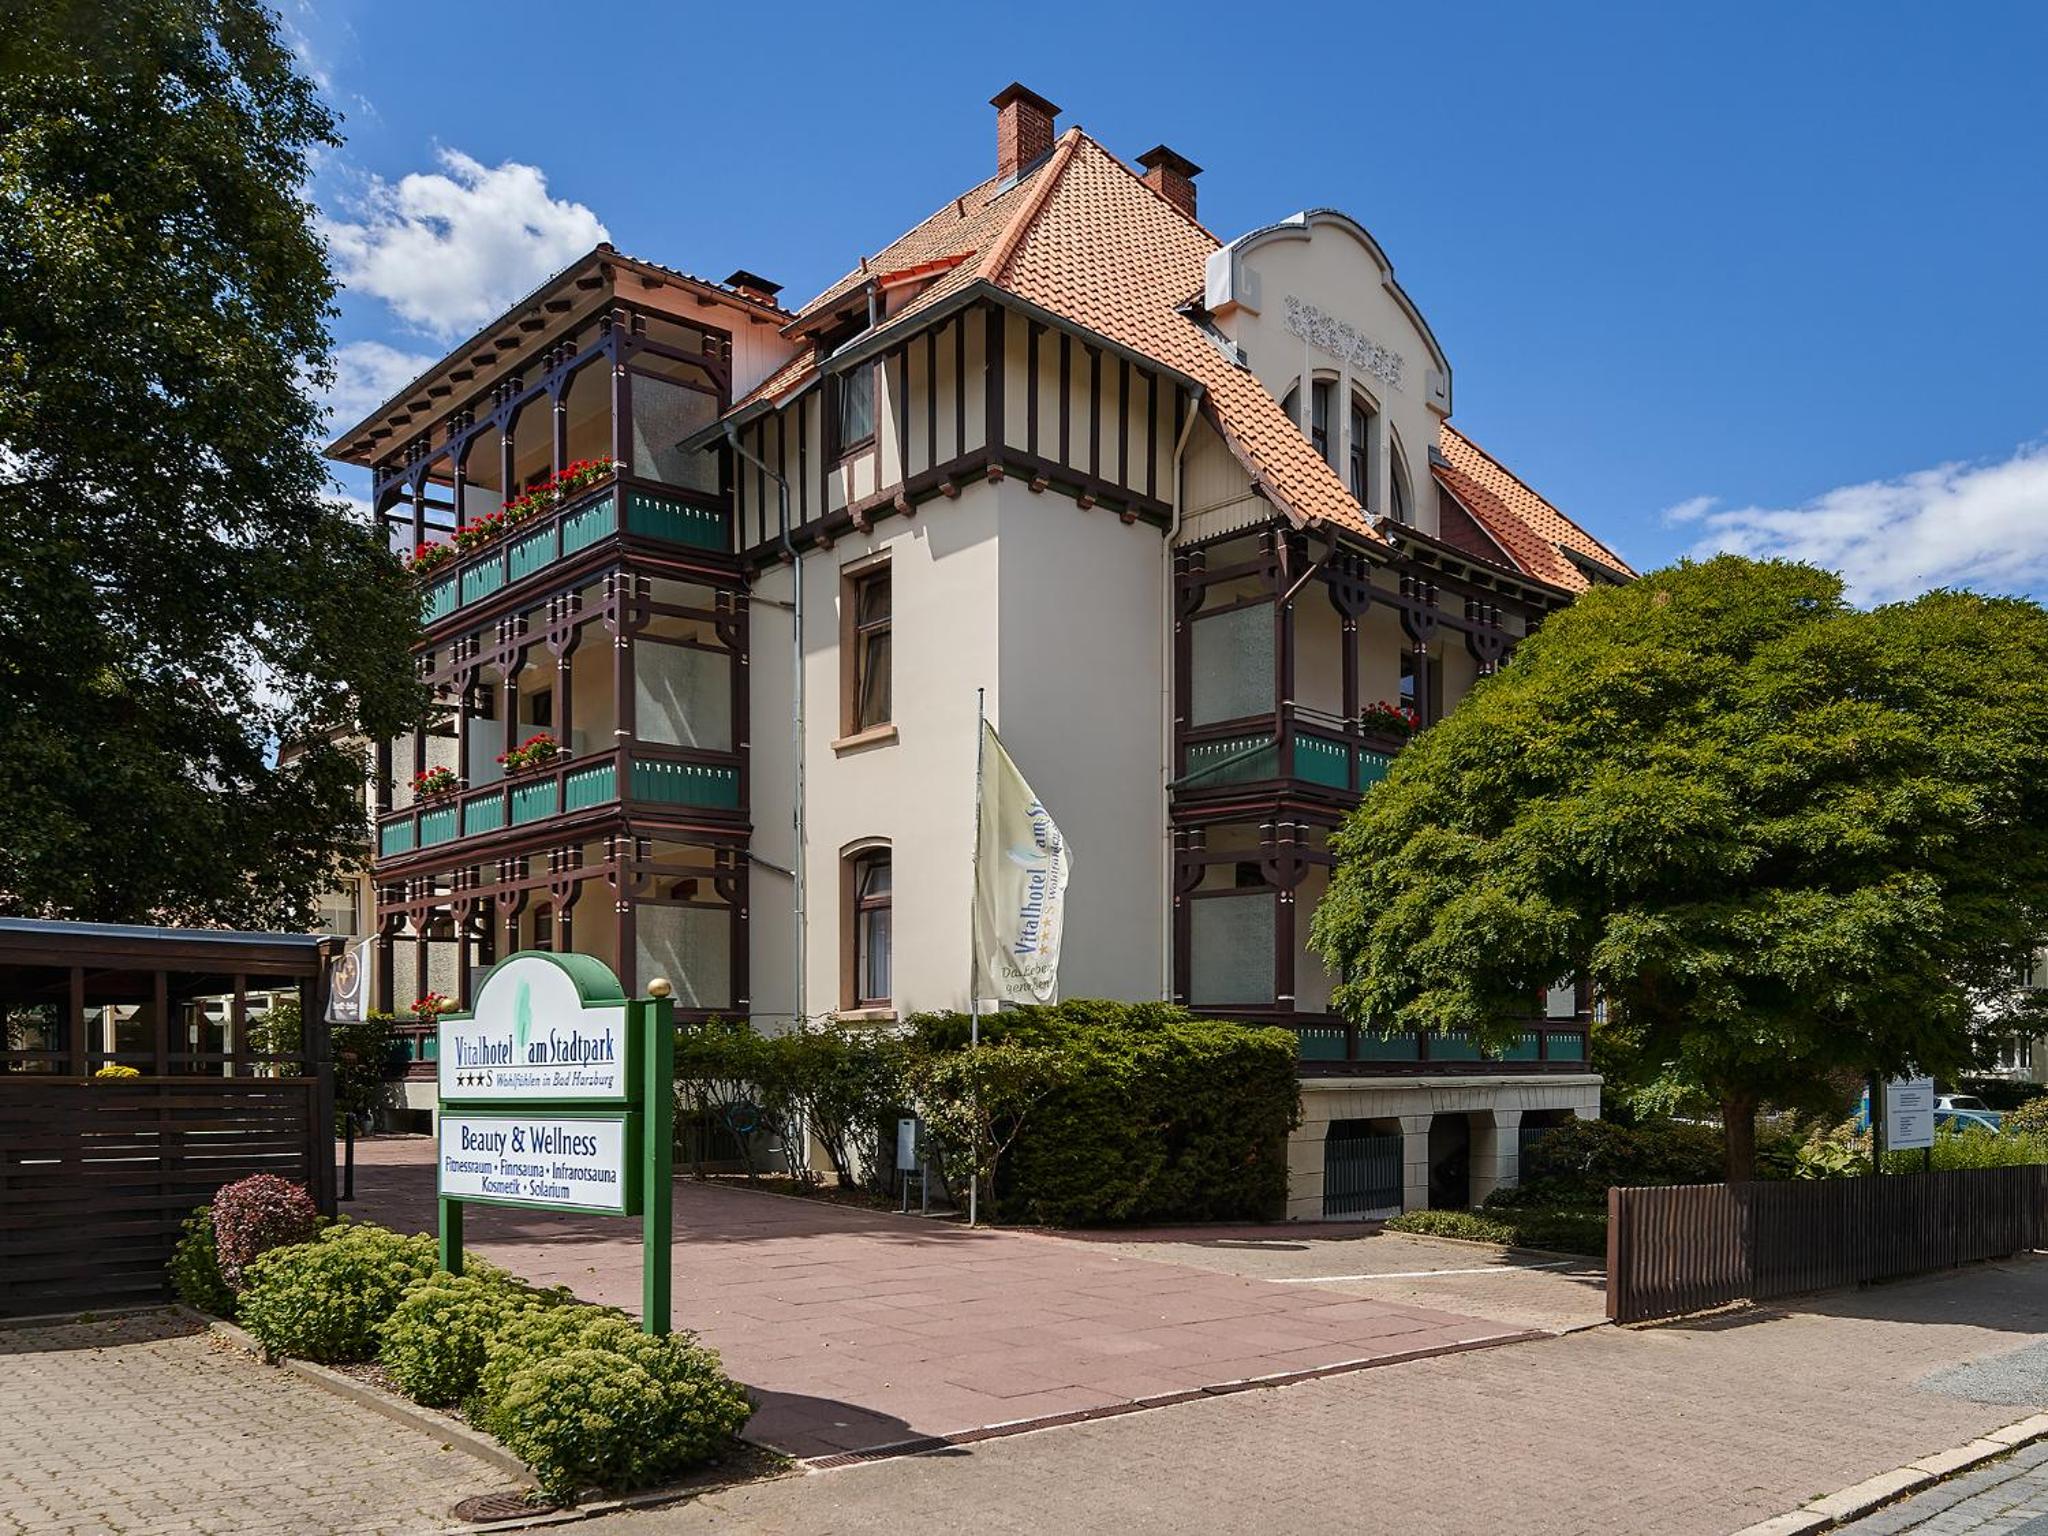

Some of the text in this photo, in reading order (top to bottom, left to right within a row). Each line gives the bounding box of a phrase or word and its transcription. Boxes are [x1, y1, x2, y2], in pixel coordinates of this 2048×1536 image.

[1014, 869, 1046, 954] Vitalhotel
[455, 1028, 614, 1068] Vitalhotel am Stadtpark
[496, 1072, 540, 1089] Wohlfühlen
[542, 1072, 551, 1087] in
[553, 1071, 571, 1087] Bad
[572, 1070, 614, 1089] Harzburg
[461, 1125, 597, 1157] Beauty & Wellness
[445, 1156, 617, 1184] Fitnessraum Finnsauna Infrarotsauna
[481, 1176, 570, 1199] Kosmetik Solarium
